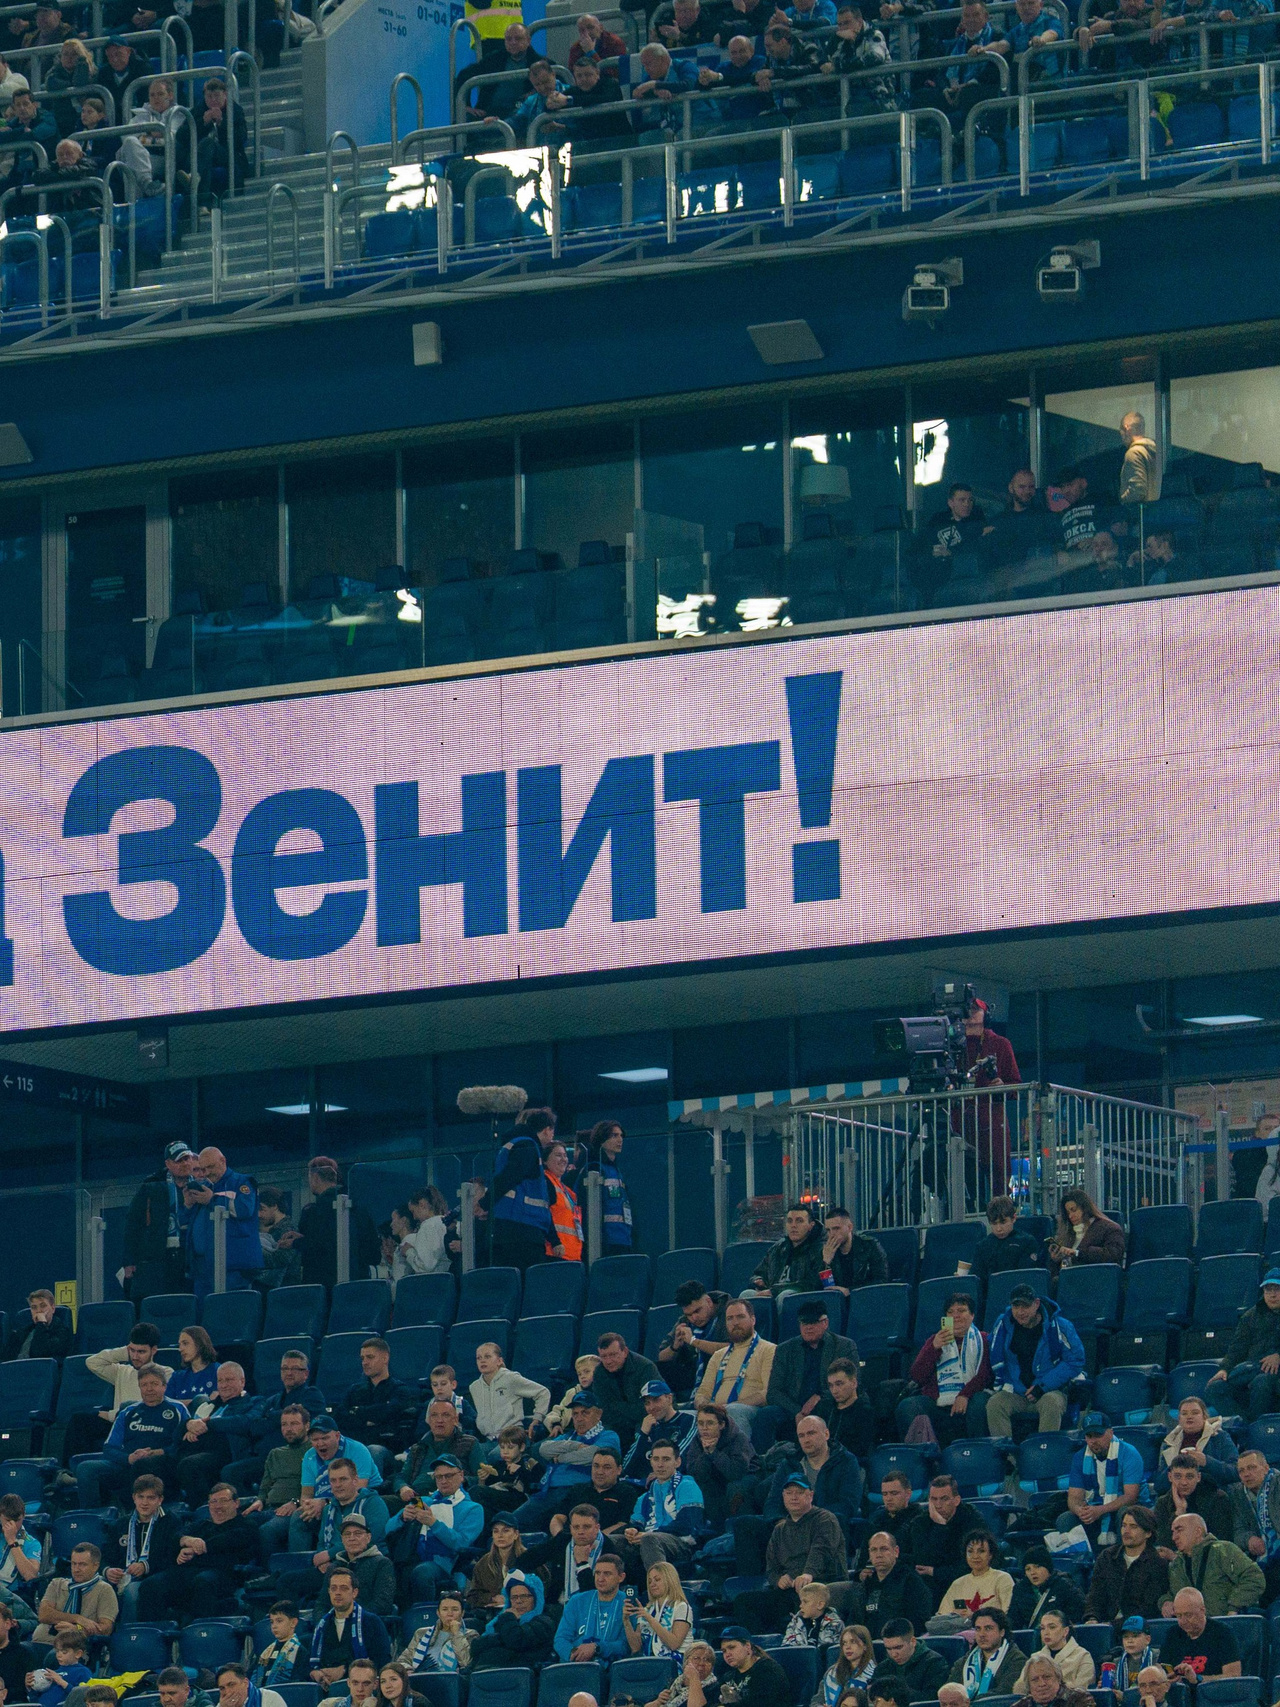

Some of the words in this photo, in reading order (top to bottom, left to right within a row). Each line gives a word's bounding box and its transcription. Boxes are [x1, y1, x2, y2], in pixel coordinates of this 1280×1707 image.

[417, 5, 447, 26] 01-04
[384, 21, 407, 37] 31-60
[66, 516, 77, 524] 50
[62, 671, 844, 976] Зенит!
[17, 1076, 34, 1093] 115
